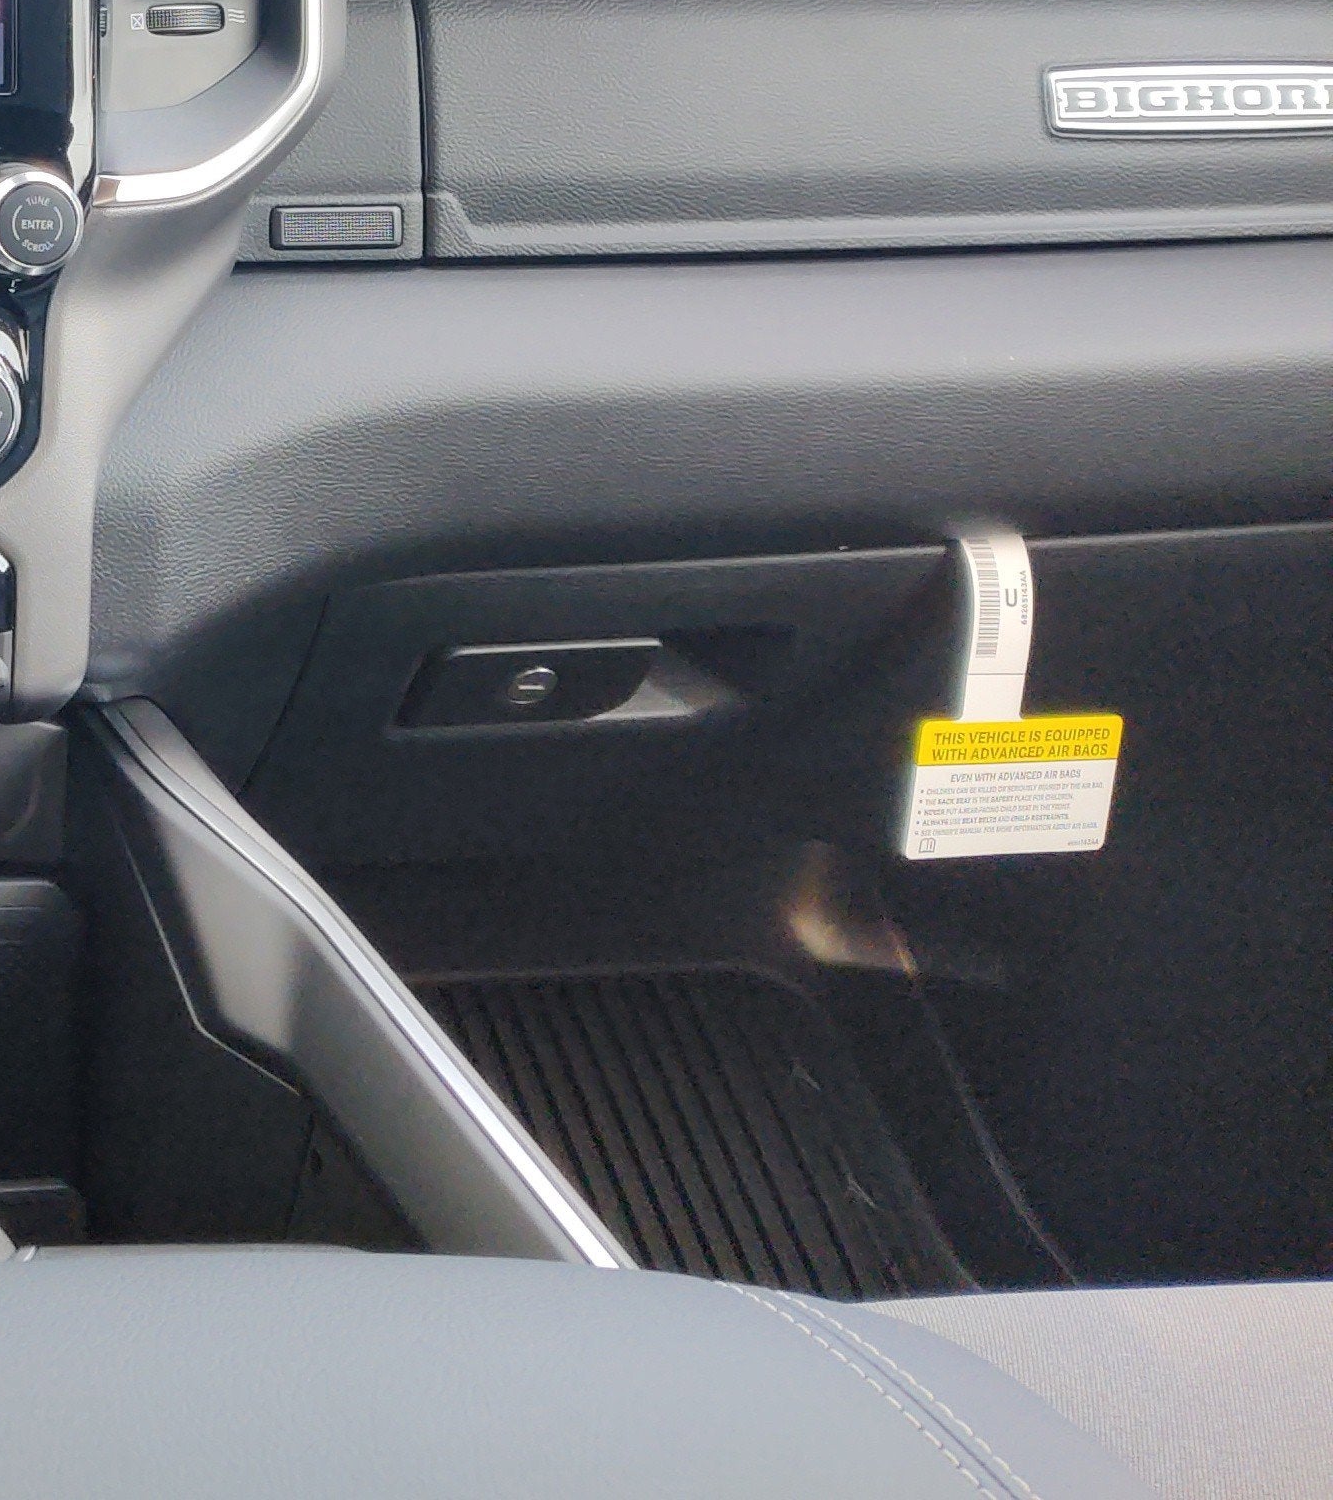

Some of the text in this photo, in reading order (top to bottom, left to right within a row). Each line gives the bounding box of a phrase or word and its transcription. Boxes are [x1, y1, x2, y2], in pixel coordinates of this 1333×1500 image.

[1061, 80, 1333, 117] BIGHOR
[24, 196, 51, 208] TUNE
[21, 219, 54, 231] ENTER
[21, 239, 55, 253] SCROLL
[934, 728, 1111, 746] THIS VEHICLE IS EQUIPPED
[932, 743, 1108, 761] WITH ADVANCED AIR BAGS
[950, 774, 973, 783] EVEN
[974, 772, 997, 782] WITH
[997, 771, 1043, 781] ADVANCED
[1044, 770, 1058, 780] AIR
